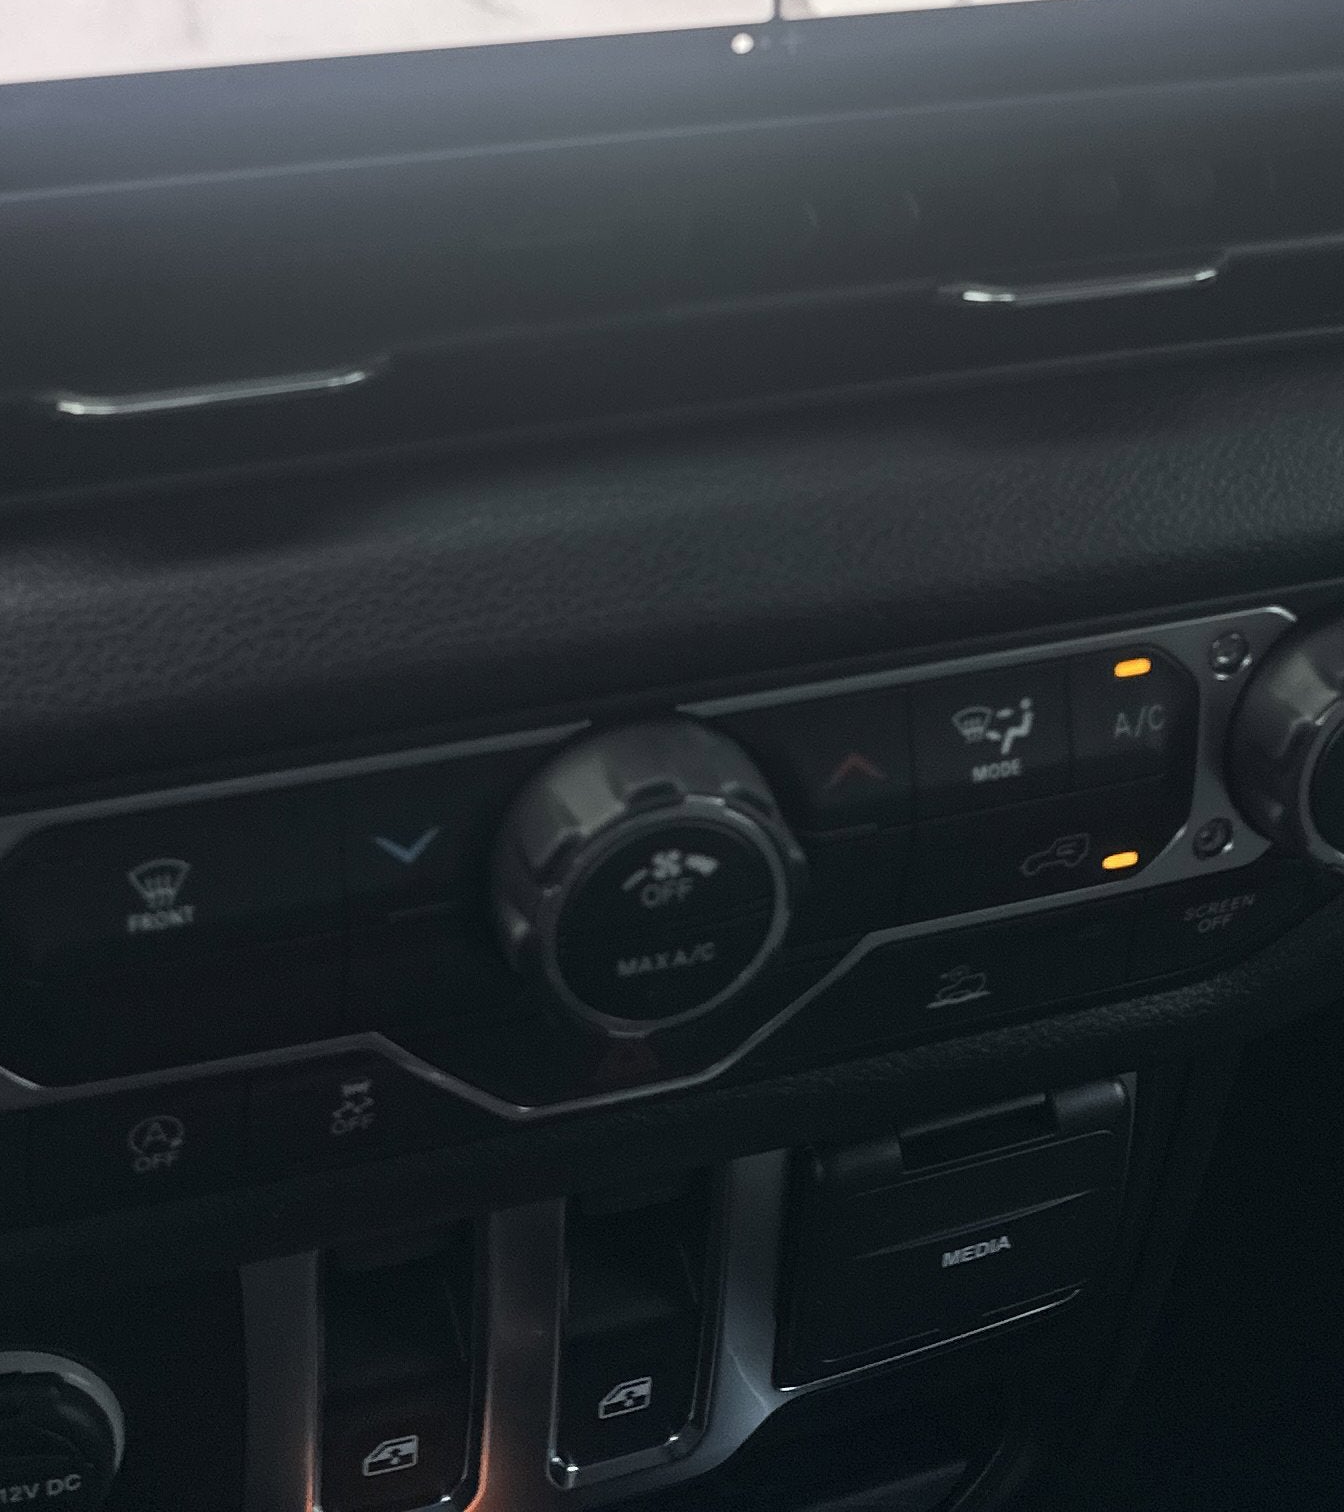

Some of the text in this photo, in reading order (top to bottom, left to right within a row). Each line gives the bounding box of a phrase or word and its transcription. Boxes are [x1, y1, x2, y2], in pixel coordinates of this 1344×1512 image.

[1115, 703, 1164, 738] A/C
[972, 758, 1021, 783] MODE
[640, 877, 694, 908] OFF
[127, 904, 195, 934] FRONT
[1183, 894, 1256, 921] SCREEN
[1197, 913, 1233, 934] OFF
[615, 952, 669, 978] MAX
[331, 1113, 375, 1136] OFF
[133, 1149, 179, 1173] OFF
[941, 1235, 1012, 1268] MEDIA
[45, 1473, 82, 1497] DC
